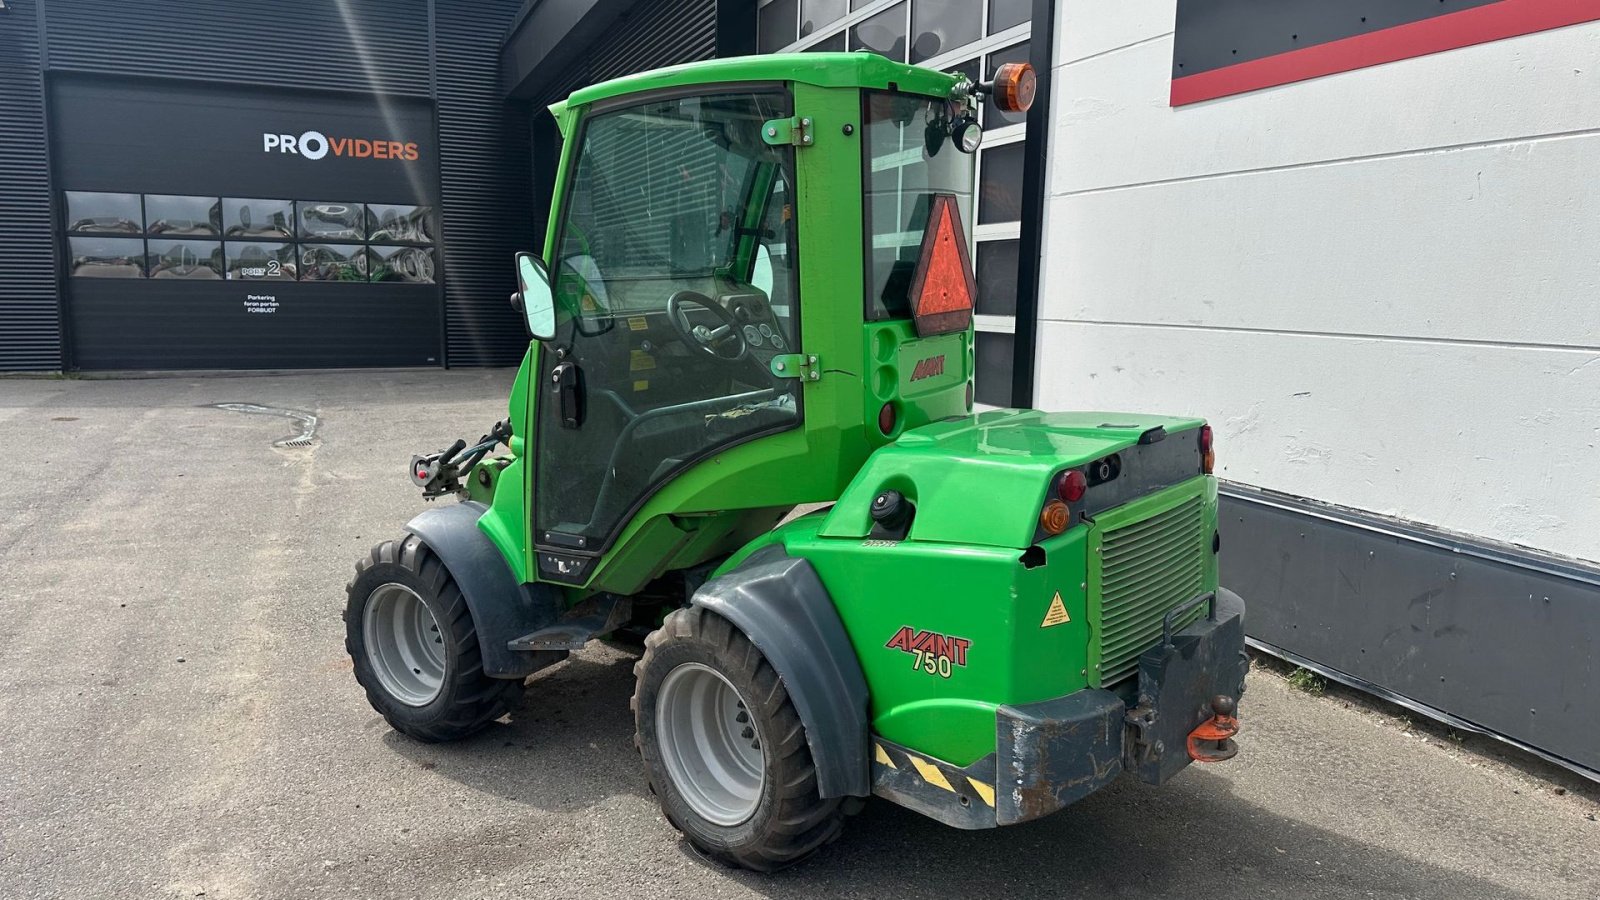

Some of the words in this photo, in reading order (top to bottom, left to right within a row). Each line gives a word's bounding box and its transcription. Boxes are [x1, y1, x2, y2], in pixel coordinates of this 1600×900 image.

[263, 131, 419, 160] PROVIDERS
[267, 260, 281, 276] 2
[247, 294, 276, 302] Parkering
[910, 354, 945, 382] AVANT
[884, 625, 972, 667] AVANT
[911, 647, 953, 680] 750
